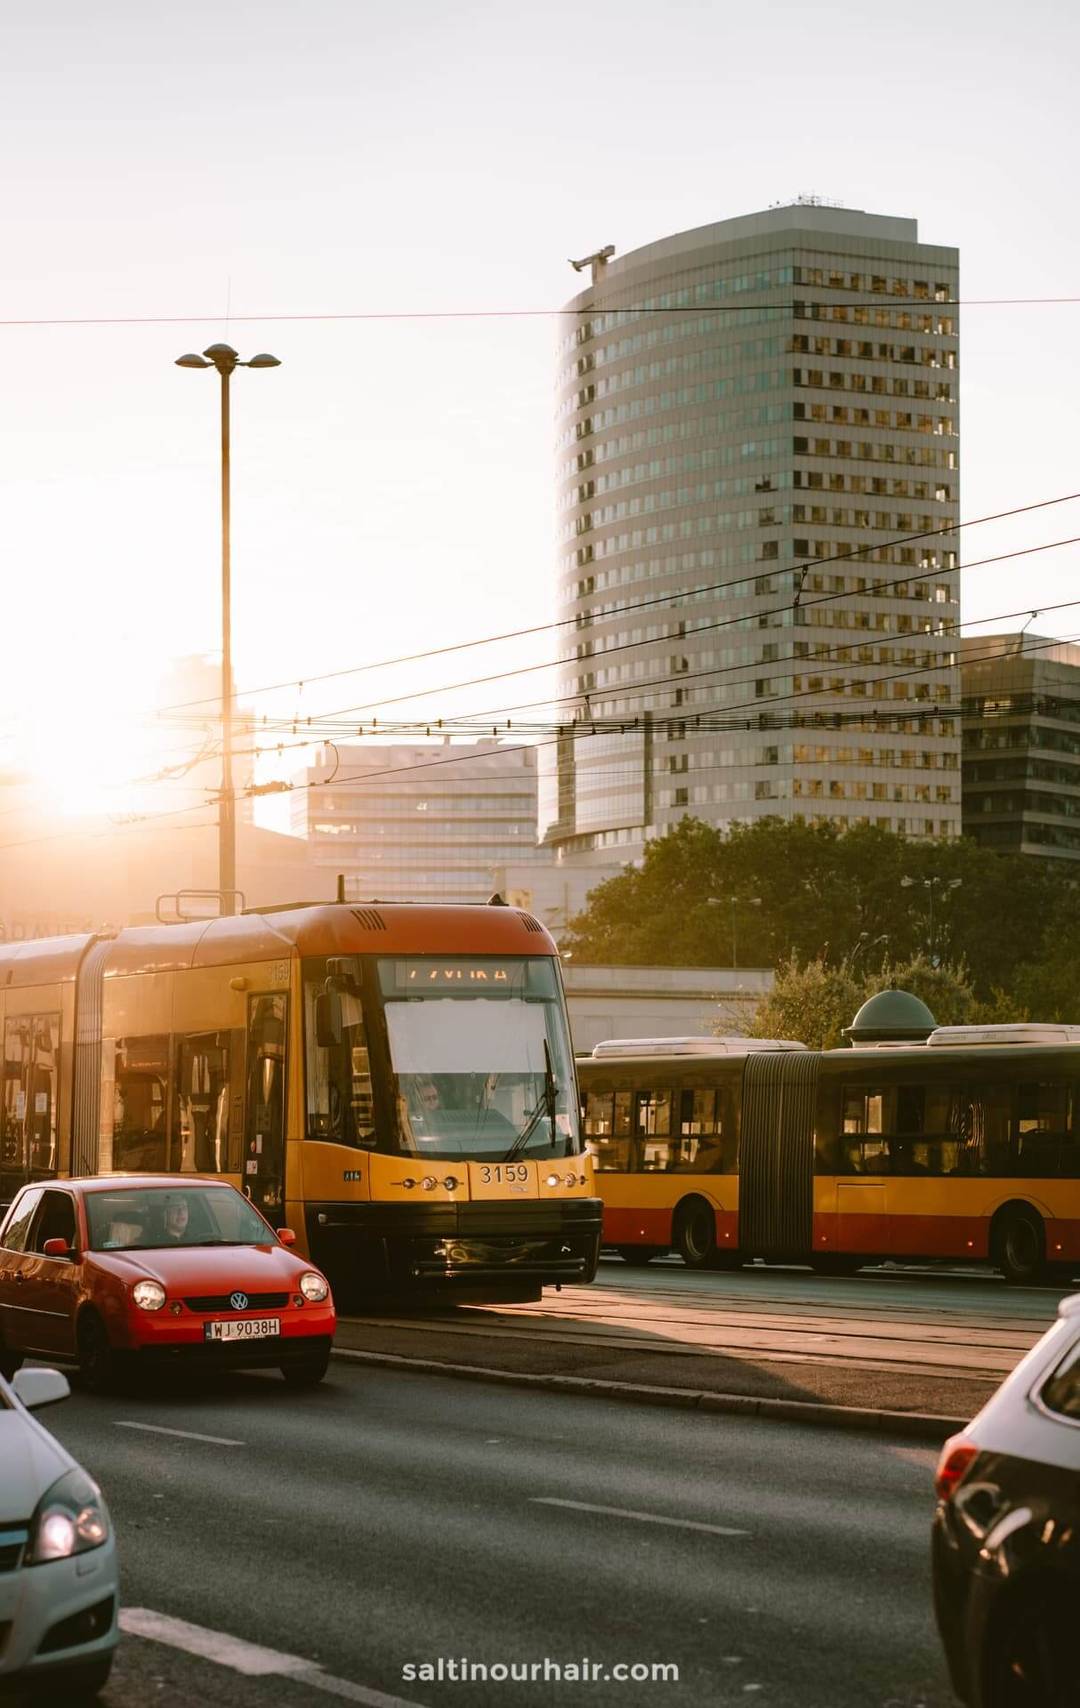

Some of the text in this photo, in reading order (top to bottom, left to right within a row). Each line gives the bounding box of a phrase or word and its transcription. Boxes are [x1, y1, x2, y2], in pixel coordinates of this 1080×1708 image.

[480, 1165, 528, 1183] 3159
[214, 1320, 277, 1337] WJ 9038H
